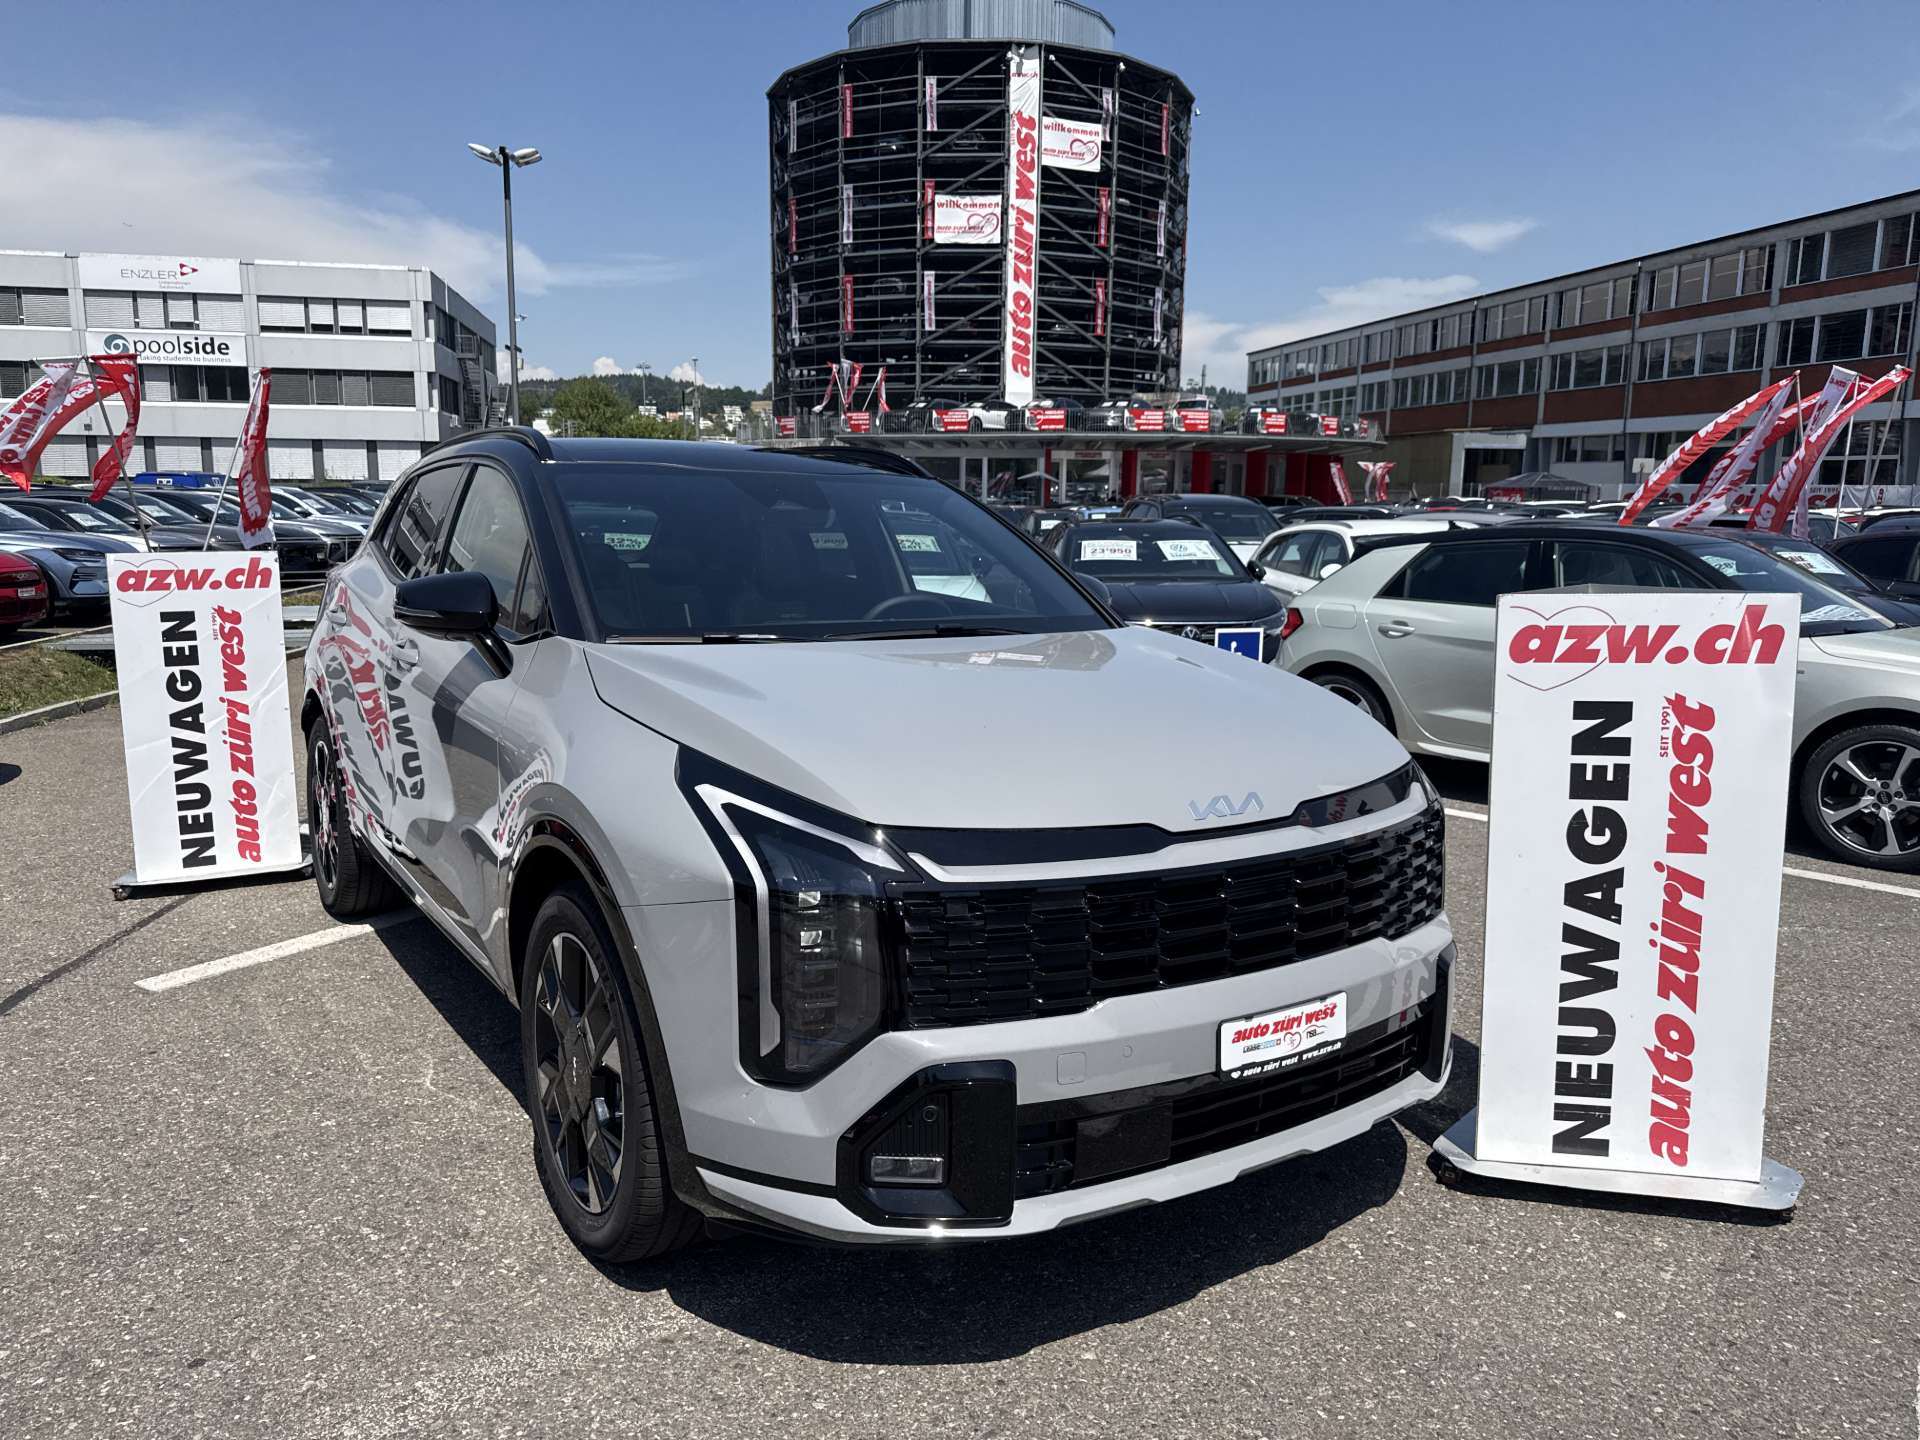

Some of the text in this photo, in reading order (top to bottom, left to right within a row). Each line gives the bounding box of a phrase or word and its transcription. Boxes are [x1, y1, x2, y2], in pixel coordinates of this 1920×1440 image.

[1043, 122, 1100, 136] willkommen
[936, 199, 1000, 209] willkommen
[1009, 110, 1037, 377] auto züri west
[120, 268, 178, 281] ENZLER
[133, 335, 230, 356] poolside
[162, 355, 193, 363] students
[202, 356, 232, 364] business
[116, 557, 273, 592] azw.ch
[1508, 604, 1786, 665] azw.ch
[160, 610, 217, 869] NEUWAGEN
[212, 605, 262, 863] auto züri west
[1659, 706, 1671, 758] SEIT 1991
[1552, 700, 1634, 1157] NEUWAGEN
[1643, 692, 1716, 1167] auto züri west
[1231, 1002, 1338, 1044] auto züri west
